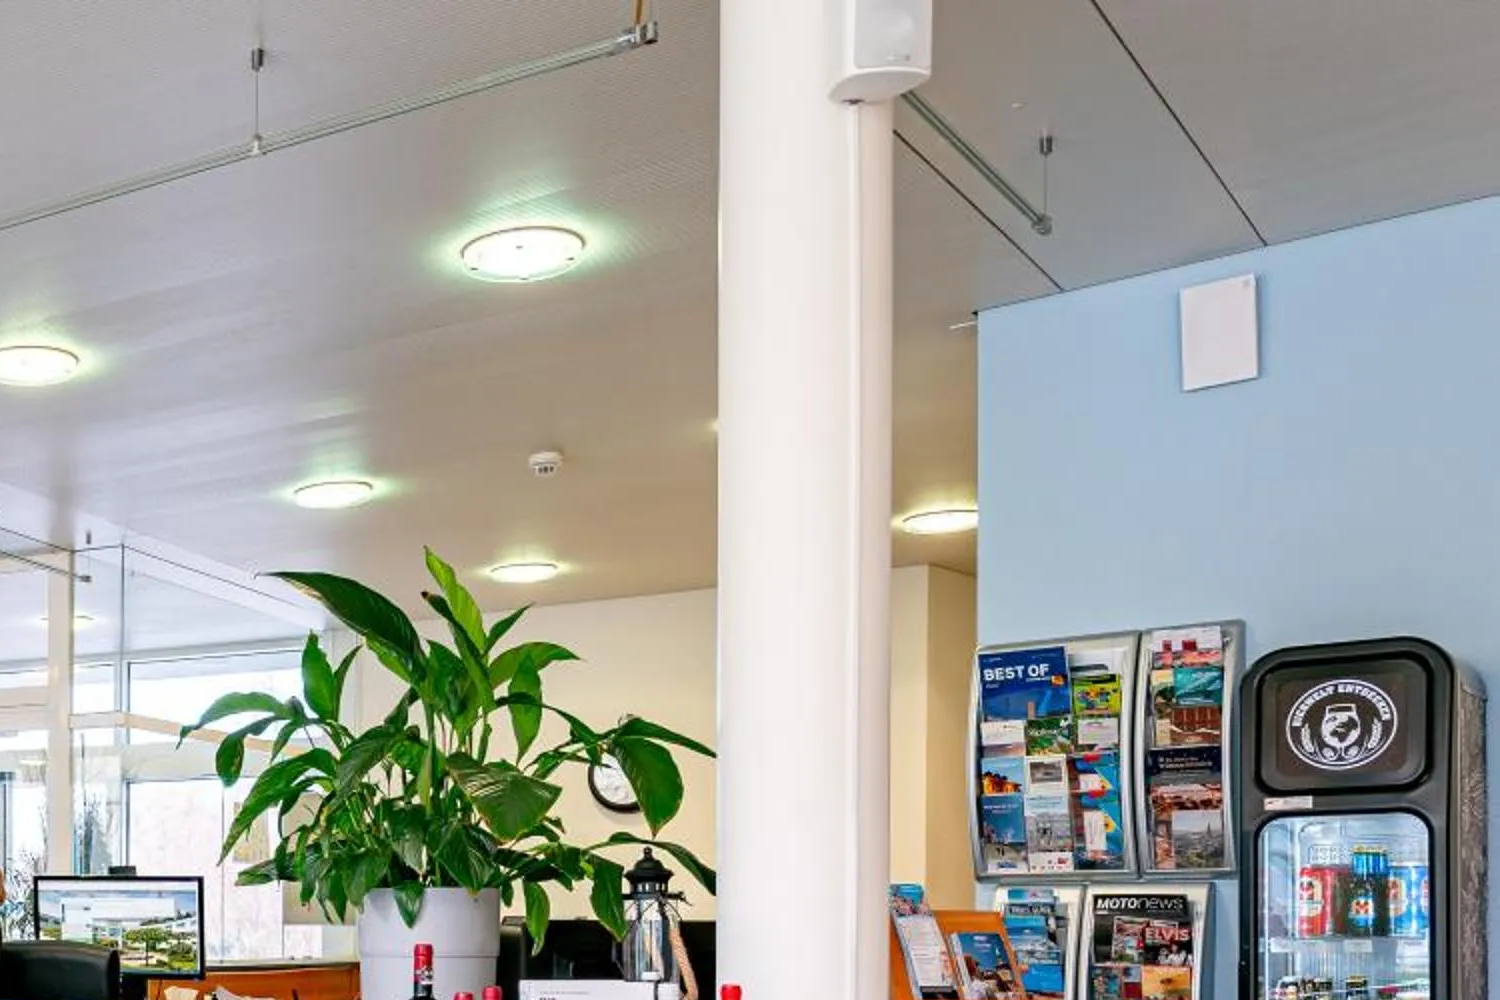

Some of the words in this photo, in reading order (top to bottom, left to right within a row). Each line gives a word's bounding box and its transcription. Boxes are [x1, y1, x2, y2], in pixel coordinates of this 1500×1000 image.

[982, 664, 1025, 681] BEST
[1027, 663, 1050, 677] OF
[1096, 897, 1184, 910] MOTOnews
[1144, 926, 1190, 942] ELVIS
